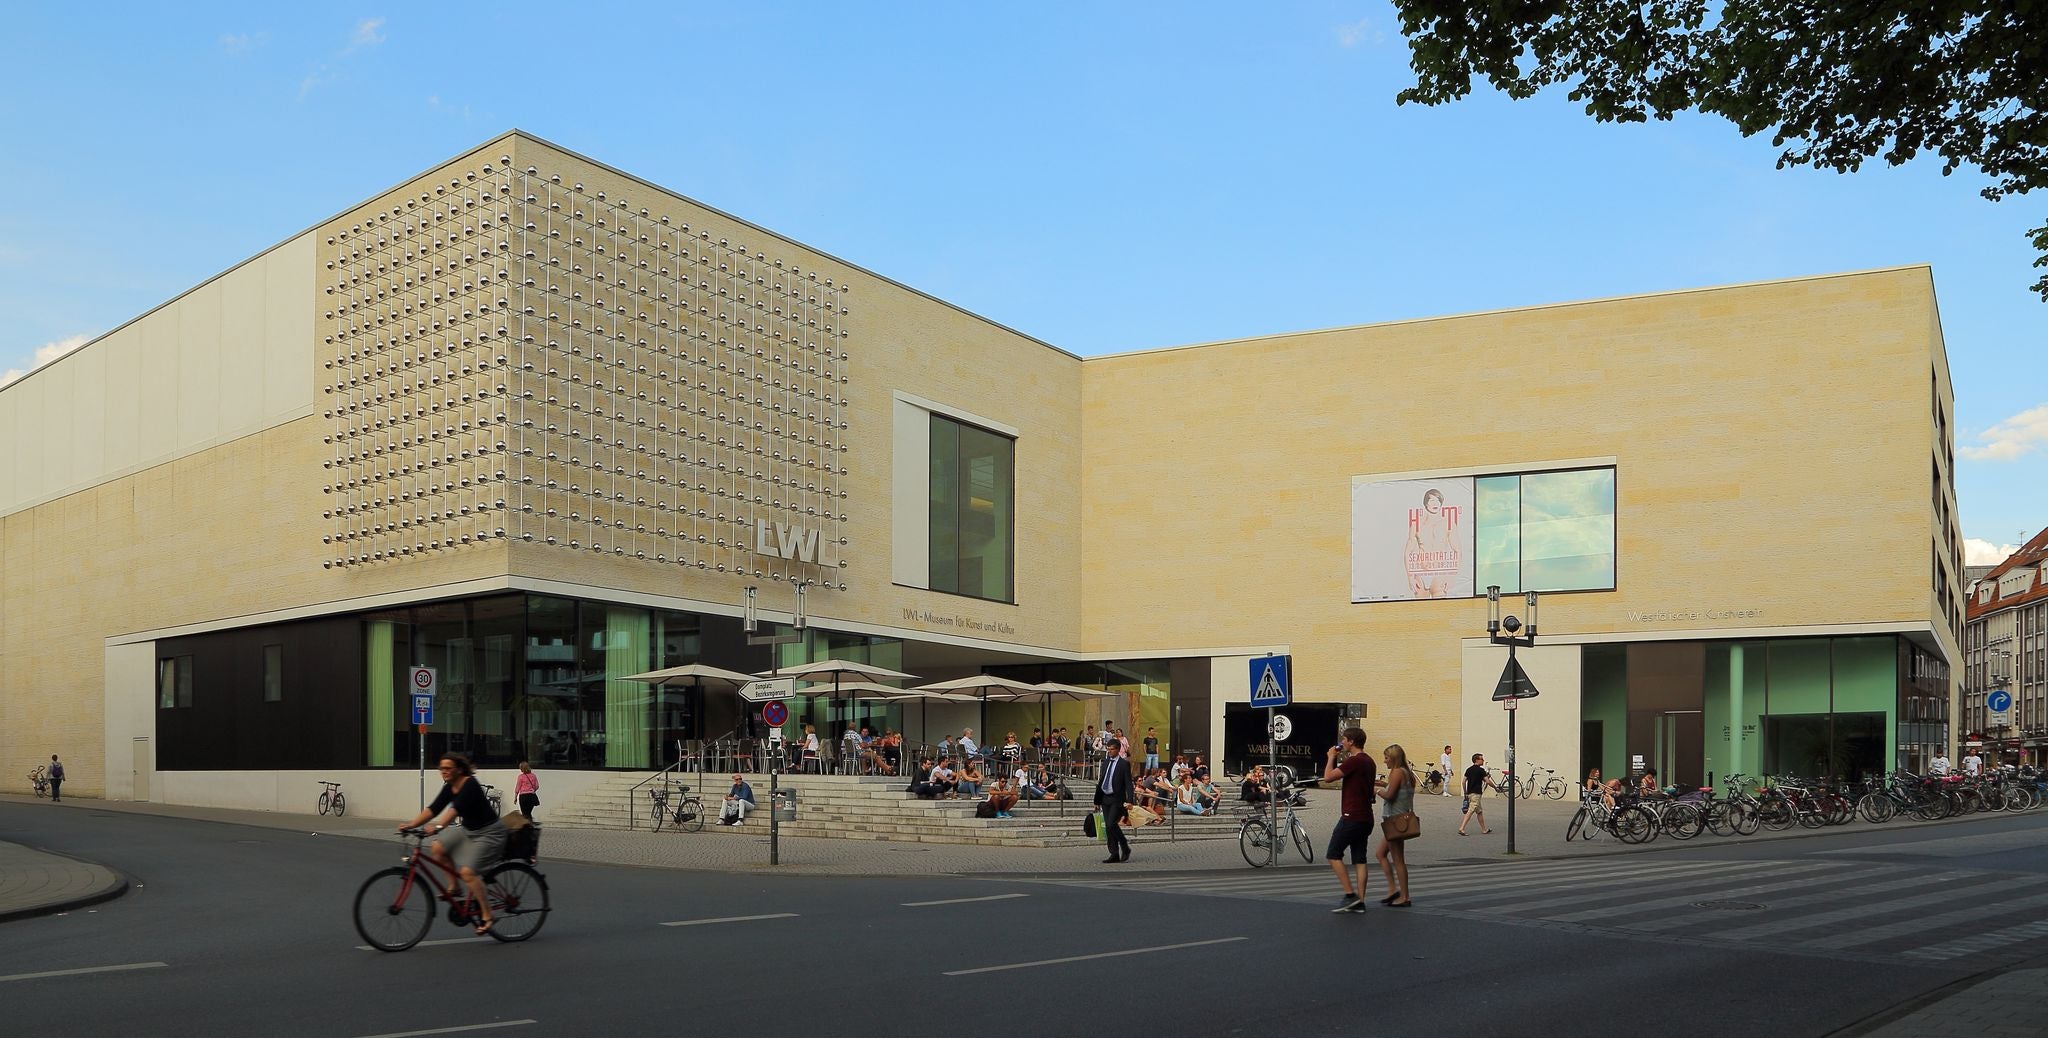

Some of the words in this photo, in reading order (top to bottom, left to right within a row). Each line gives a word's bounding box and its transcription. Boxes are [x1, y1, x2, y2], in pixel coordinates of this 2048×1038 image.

[757, 518, 840, 568] LWL
[1705, 608, 1764, 620] Kunstverein
[955, 615, 965, 627] für
[966, 617, 983, 629] Kunst
[984, 622, 996, 632] und
[998, 623, 1015, 634] Kultur
[418, 674, 429, 683] 30
[1247, 743, 1312, 755] WARTEINER
